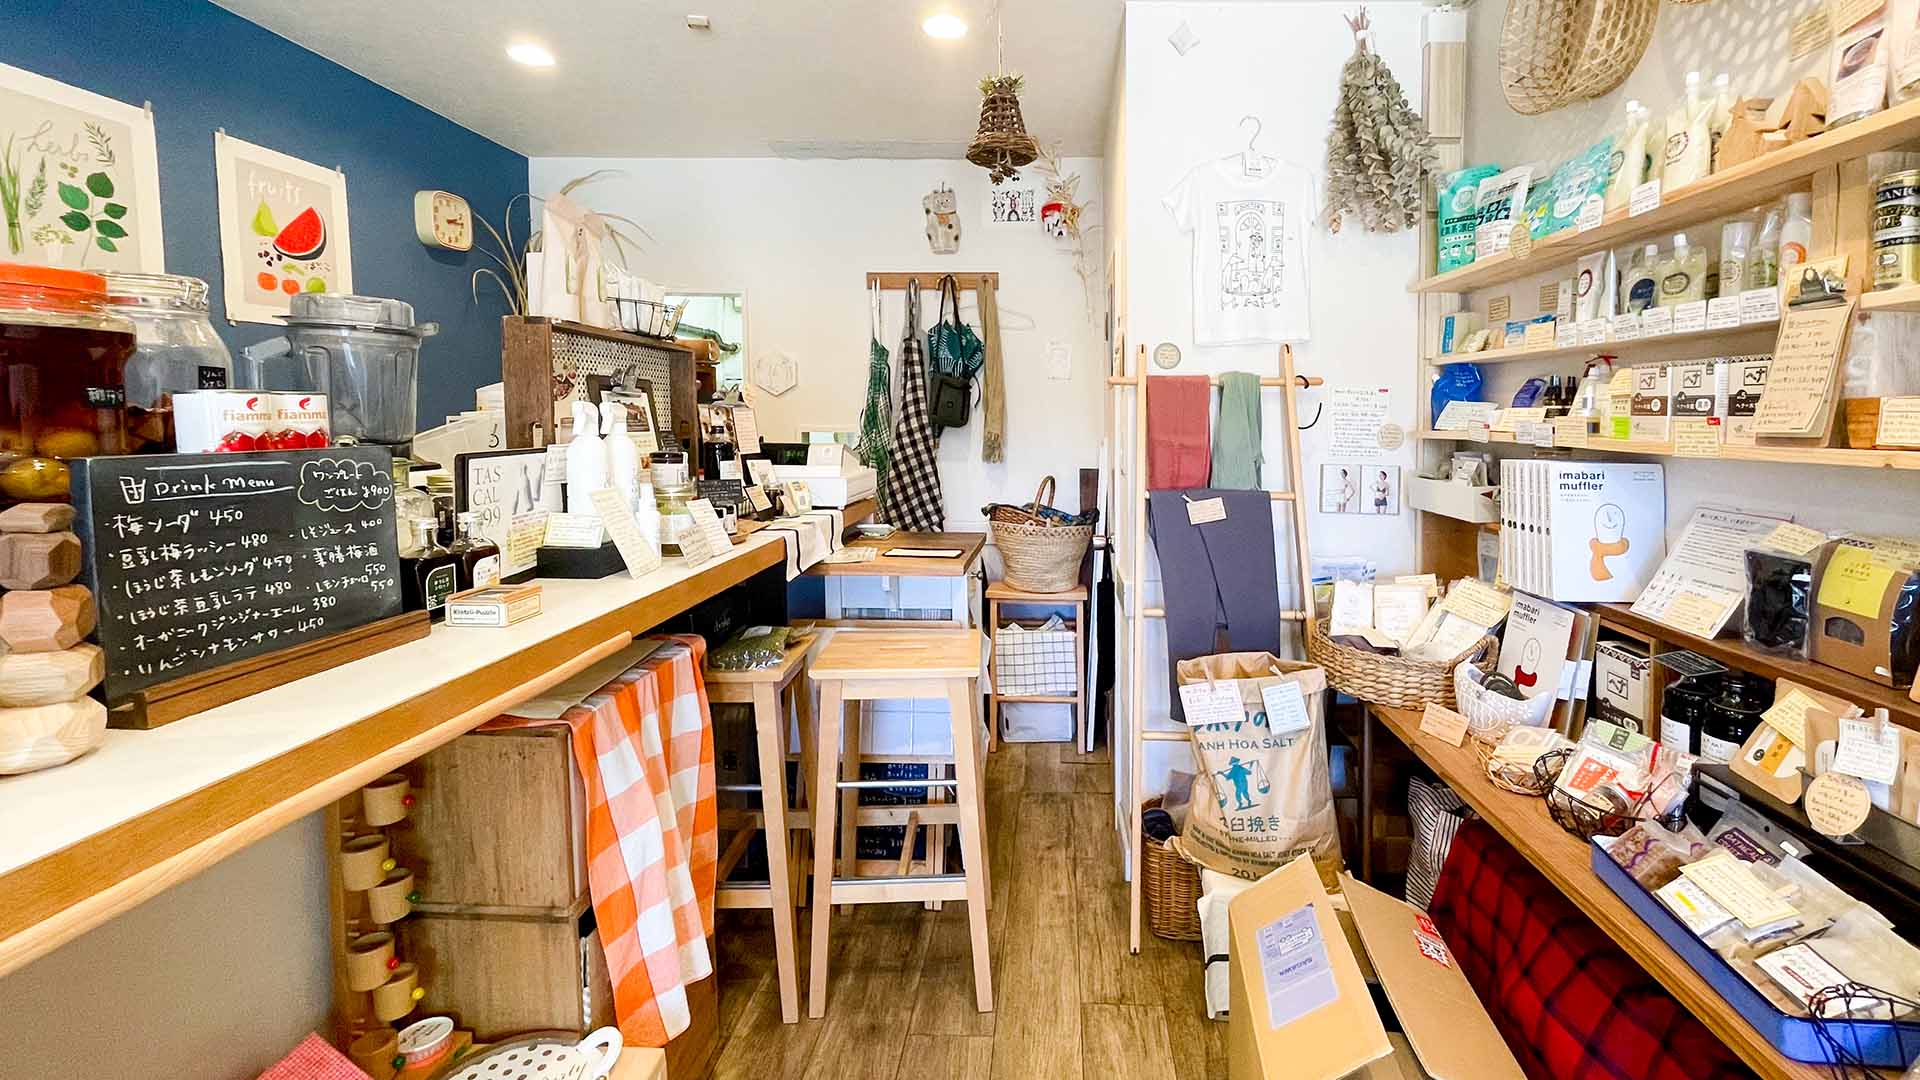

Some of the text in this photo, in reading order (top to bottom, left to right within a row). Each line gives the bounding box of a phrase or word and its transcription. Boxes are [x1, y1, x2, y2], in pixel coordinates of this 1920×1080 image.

[248, 169, 303, 203] fruits
[1745, 369, 1766, 384] ヘナ
[223, 408, 272, 421] fiamm
[1559, 471, 1605, 480] imabari
[153, 474, 275, 497] Drink Menu
[324, 487, 358, 499] ごはん
[1559, 481, 1604, 491] muffler
[112, 509, 244, 539] 梅ソーダ 450
[302, 518, 383, 540] しそジュース 400
[119, 533, 268, 569] 豆乳梅ラッシー 480
[262, 554, 293, 570] 450
[365, 563, 387, 576] 550
[370, 578, 394, 592] 550
[130, 580, 292, 625] ほうじ茶豆乳ラテ 480
[312, 596, 336, 612] 380
[137, 616, 325, 674] りんごシナモンサワー 450
[1199, 737, 1296, 751] ANH HOA SALT
